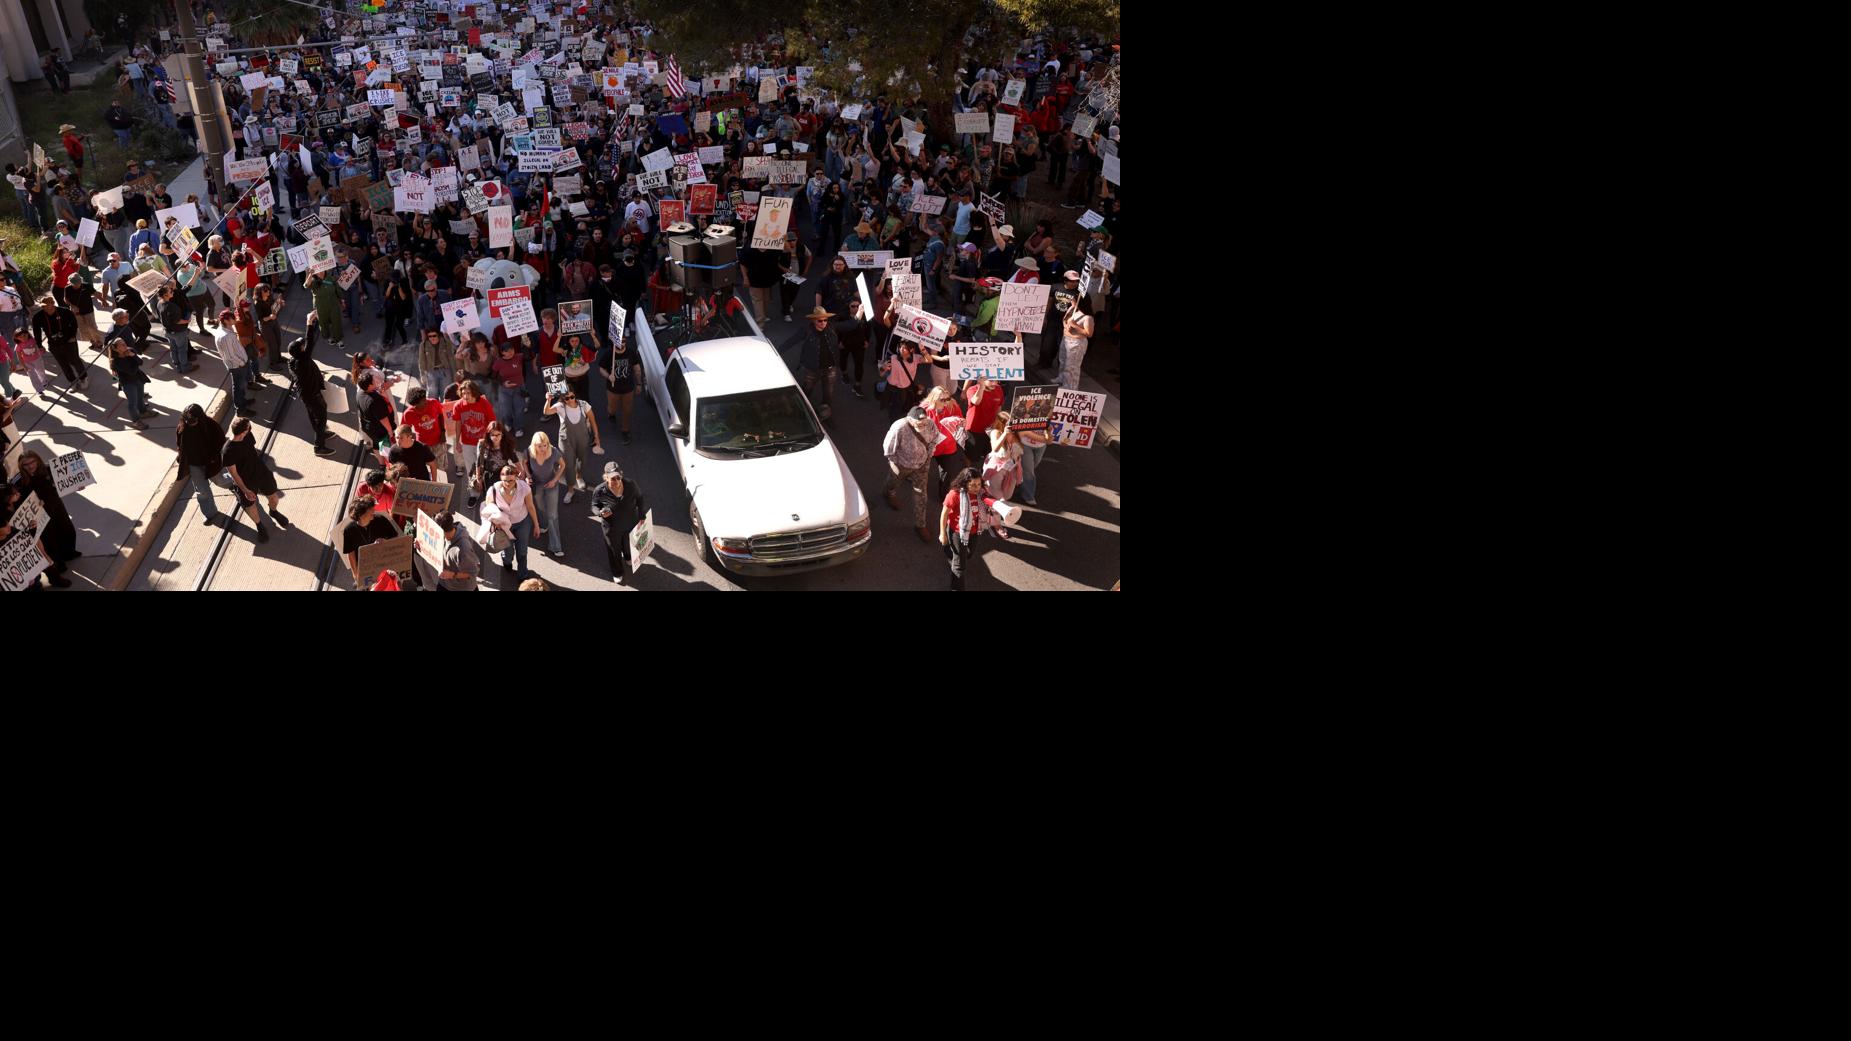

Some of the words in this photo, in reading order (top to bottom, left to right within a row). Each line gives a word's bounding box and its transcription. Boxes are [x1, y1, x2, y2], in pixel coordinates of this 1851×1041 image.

[304, 57, 320, 65] RESIST
[496, 108, 509, 118] NOT
[642, 176, 660, 186] NOT
[407, 192, 424, 200] NOT
[913, 202, 942, 213] OUT
[296, 215, 321, 232] DEPORT
[497, 289, 521, 299] ARMS
[896, 328, 911, 337] PROTECT
[955, 345, 1022, 356] HISTORY
[543, 368, 552, 378] ICE
[552, 367, 563, 375] OUT
[551, 374, 558, 382] OF
[958, 367, 1024, 380] SILENT
[545, 379, 568, 394] TUCSON
[1019, 393, 1052, 402] VIOLENCE
[1055, 398, 1097, 412] ILLEGAL
[1019, 416, 1048, 424] DOMESTIC
[1050, 411, 1098, 427] STOLEN
[1011, 422, 1047, 431] TERRORISM
[52, 459, 59, 469] I
[60, 451, 83, 466] PREFER
[56, 466, 68, 477] MY
[70, 460, 86, 472] ICE
[57, 472, 86, 492] CRUSHED
[399, 491, 445, 504] COMMITS
[12, 497, 32, 528] MELT
[19, 502, 39, 529] ICE
[419, 514, 440, 541] STOP
[0, 558, 11, 574] POR
[10, 549, 21, 561] LOS
[19, 537, 33, 551] QUE
[1, 565, 25, 589] NO
[16, 545, 43, 575] PUEDEN
